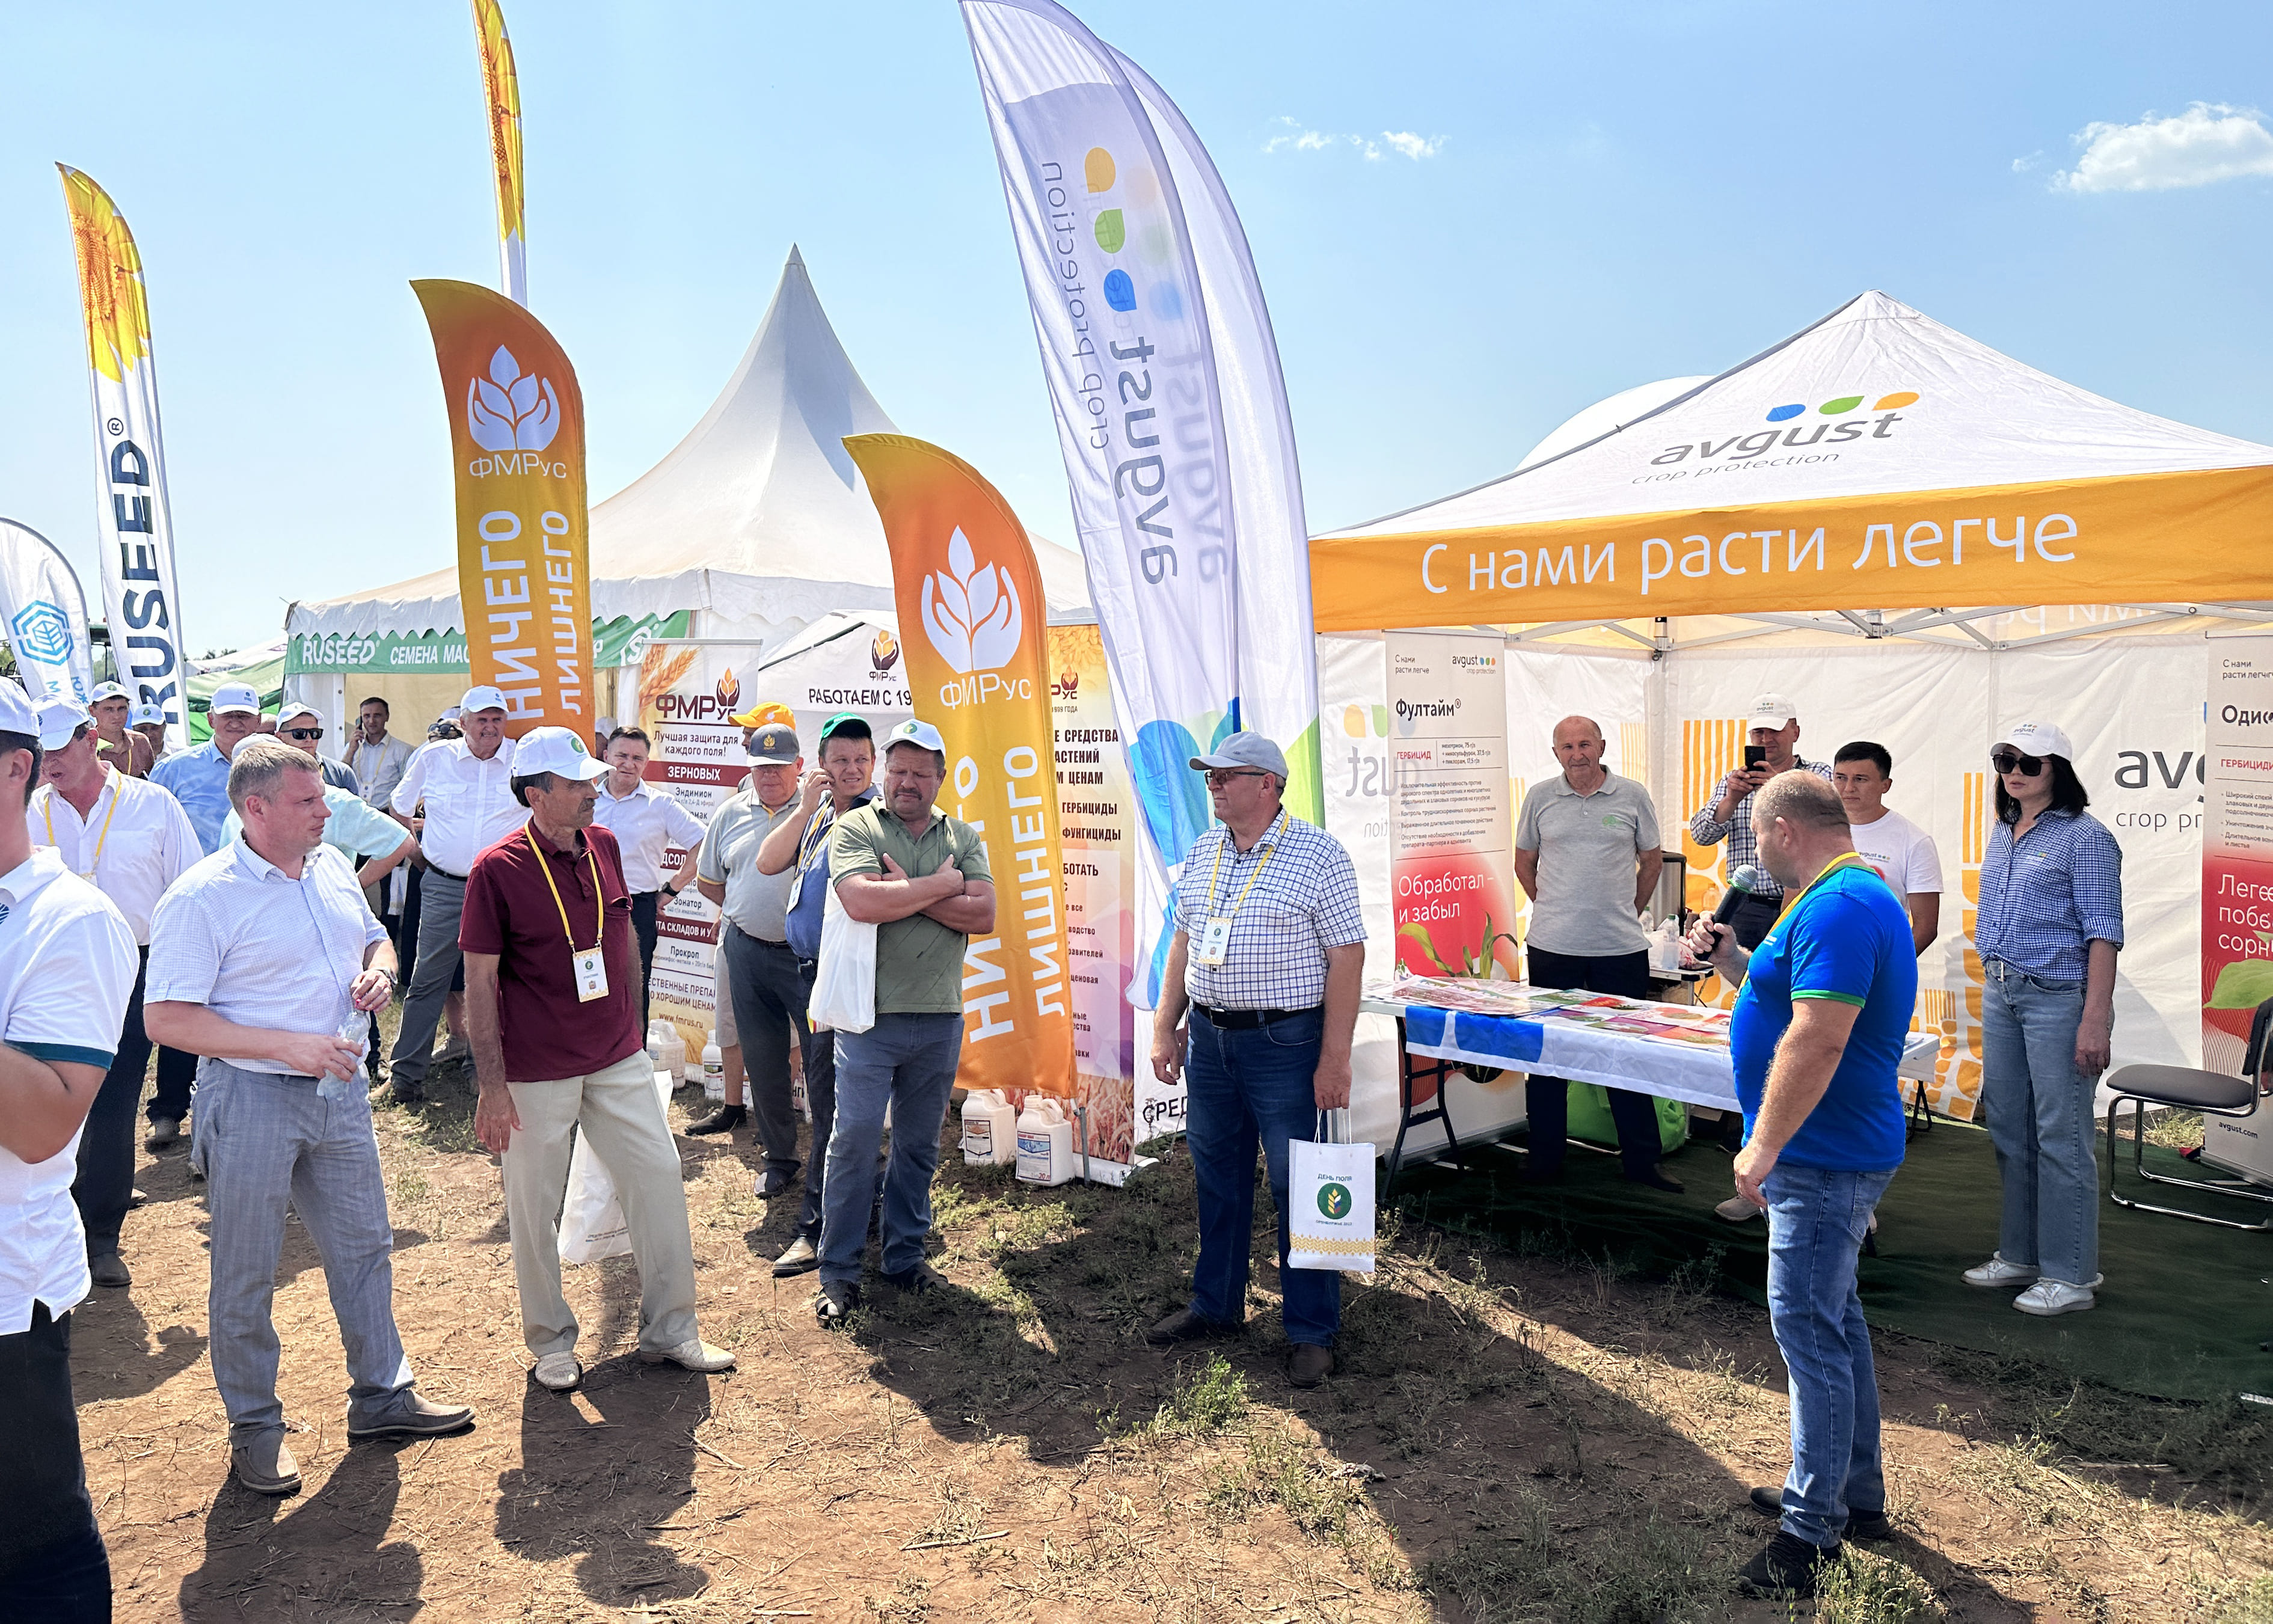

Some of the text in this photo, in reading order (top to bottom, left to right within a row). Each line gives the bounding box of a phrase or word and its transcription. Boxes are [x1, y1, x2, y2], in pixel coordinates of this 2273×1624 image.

[1651, 412, 1903, 465] avgust
[1632, 453, 1839, 485] crop protection
[1421, 513, 2078, 595] С нами расти легче
[479, 510, 544, 720] НИЧЕГО
[541, 511, 581, 715] ЛИШНЕГО
[390, 644, 470, 664] СЕМЕНА МАС
[1395, 654, 1400, 663] С
[1452, 655, 1478, 667] avgust
[2222, 672, 2246, 680] расти
[809, 688, 912, 705] РАБОТАЕМ С 19
[654, 731, 738, 746] Лучшая защита для
[1065, 729, 1118, 744] СРЕДСТВА
[665, 747, 726, 757] каждого поля!
[1055, 749, 1099, 763] АСТЕНИЙ
[1397, 750, 1431, 760] ГЕРБИЦИД
[667, 765, 721, 780] ЗЕРНОВЫХ
[1069, 771, 1103, 786] ЦЕНАМ
[675, 787, 712, 798] Эндимион
[1062, 803, 1117, 816] ГЕРБИЦИДЫ
[2116, 813, 2167, 832] crop
[1063, 827, 1121, 842] ФУНГИЦИДЫ
[1063, 863, 1099, 876] БОТАТЬ
[1004, 746, 1066, 1016] ЛИШНЕГО
[1399, 872, 1484, 899] Обработал
[673, 896, 702, 909] Зонатор
[1399, 899, 1460, 923] и забыл
[667, 921, 699, 936] СКЛАДОВ
[670, 946, 699, 959] Прокроп
[648, 977, 689, 993] ЕСТВЕННЫЕ
[656, 992, 691, 1007] ХОРОШИМ
[658, 1012, 704, 1029] www.fmrus.ru
[2218, 1121, 2258, 1139] avgust.com
